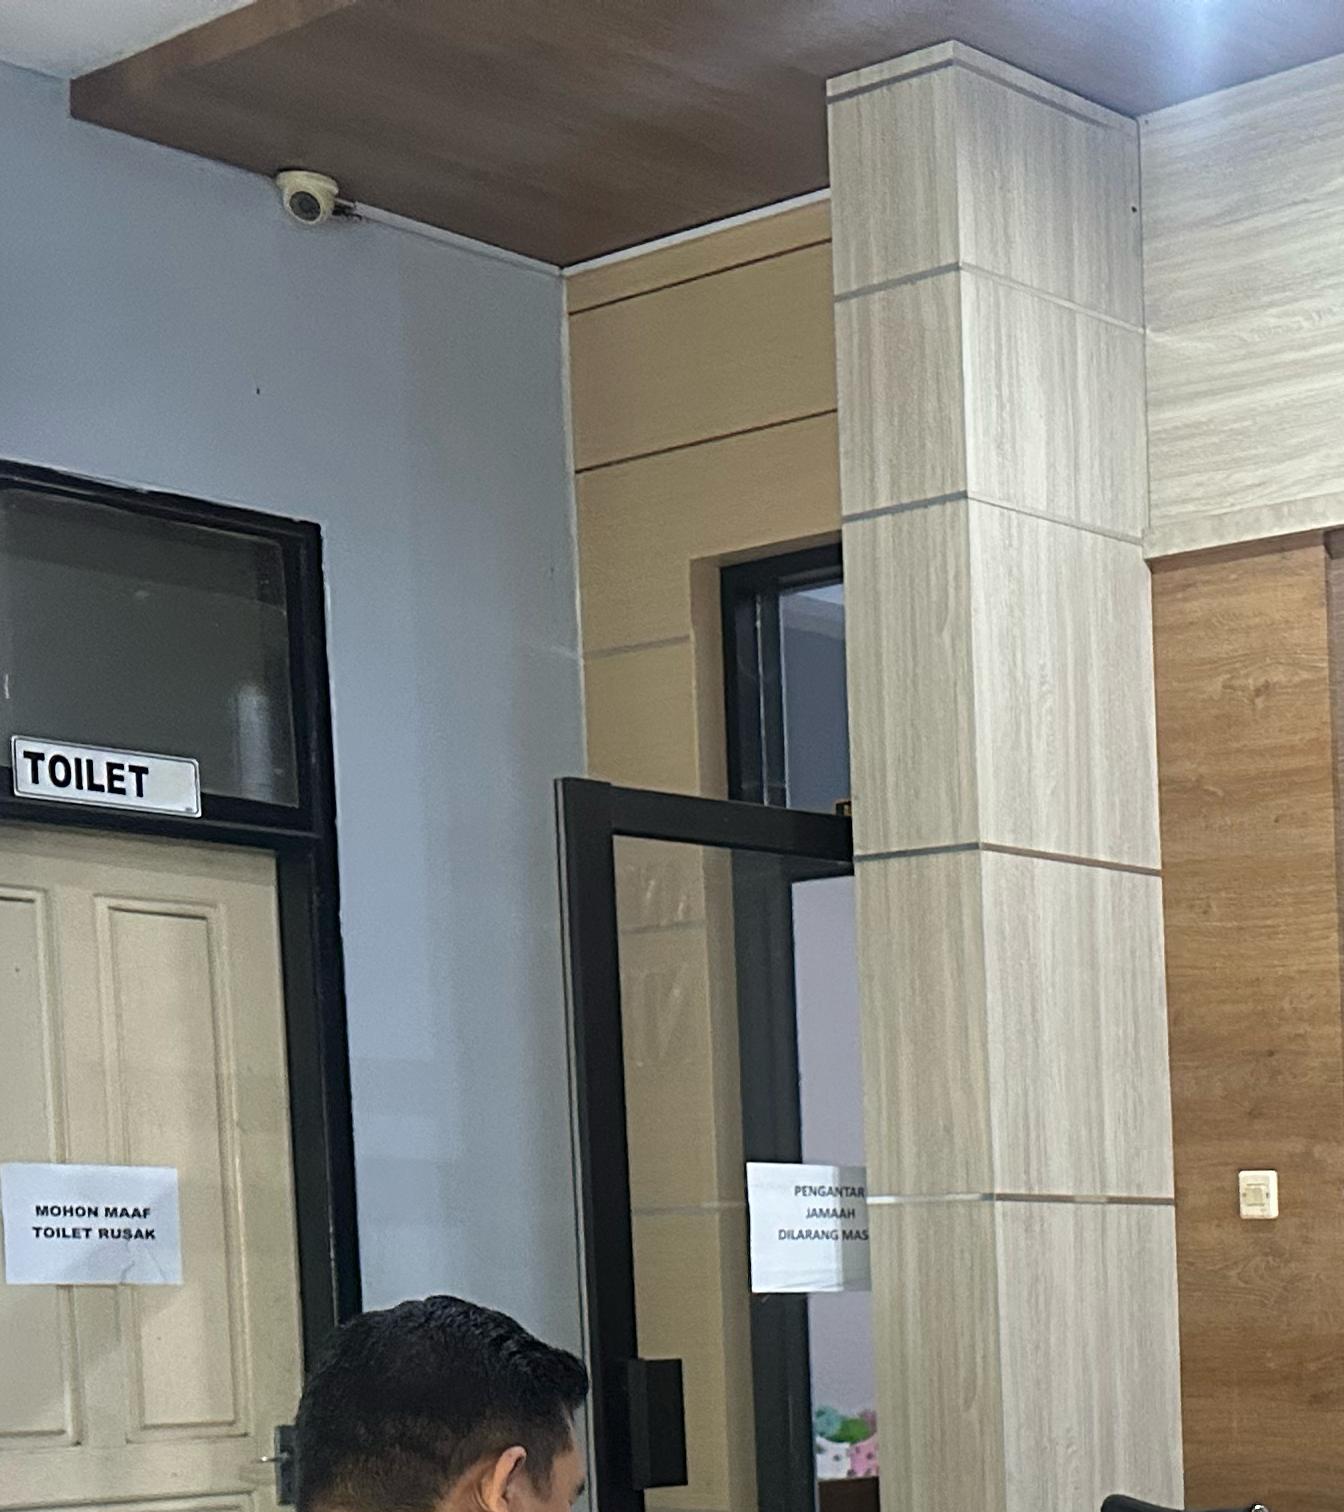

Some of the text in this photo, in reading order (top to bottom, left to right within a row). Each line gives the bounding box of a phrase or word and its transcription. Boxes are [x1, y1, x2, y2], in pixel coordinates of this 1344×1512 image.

[22, 750, 149, 798] TOILET
[794, 1185, 865, 1198] PENGANTAR
[35, 1205, 151, 1219] MOHON MAAF
[805, 1208, 856, 1219] JAMAAH
[32, 1226, 156, 1240] TOILET RUSAK
[778, 1228, 869, 1241] DILARANG MAS
